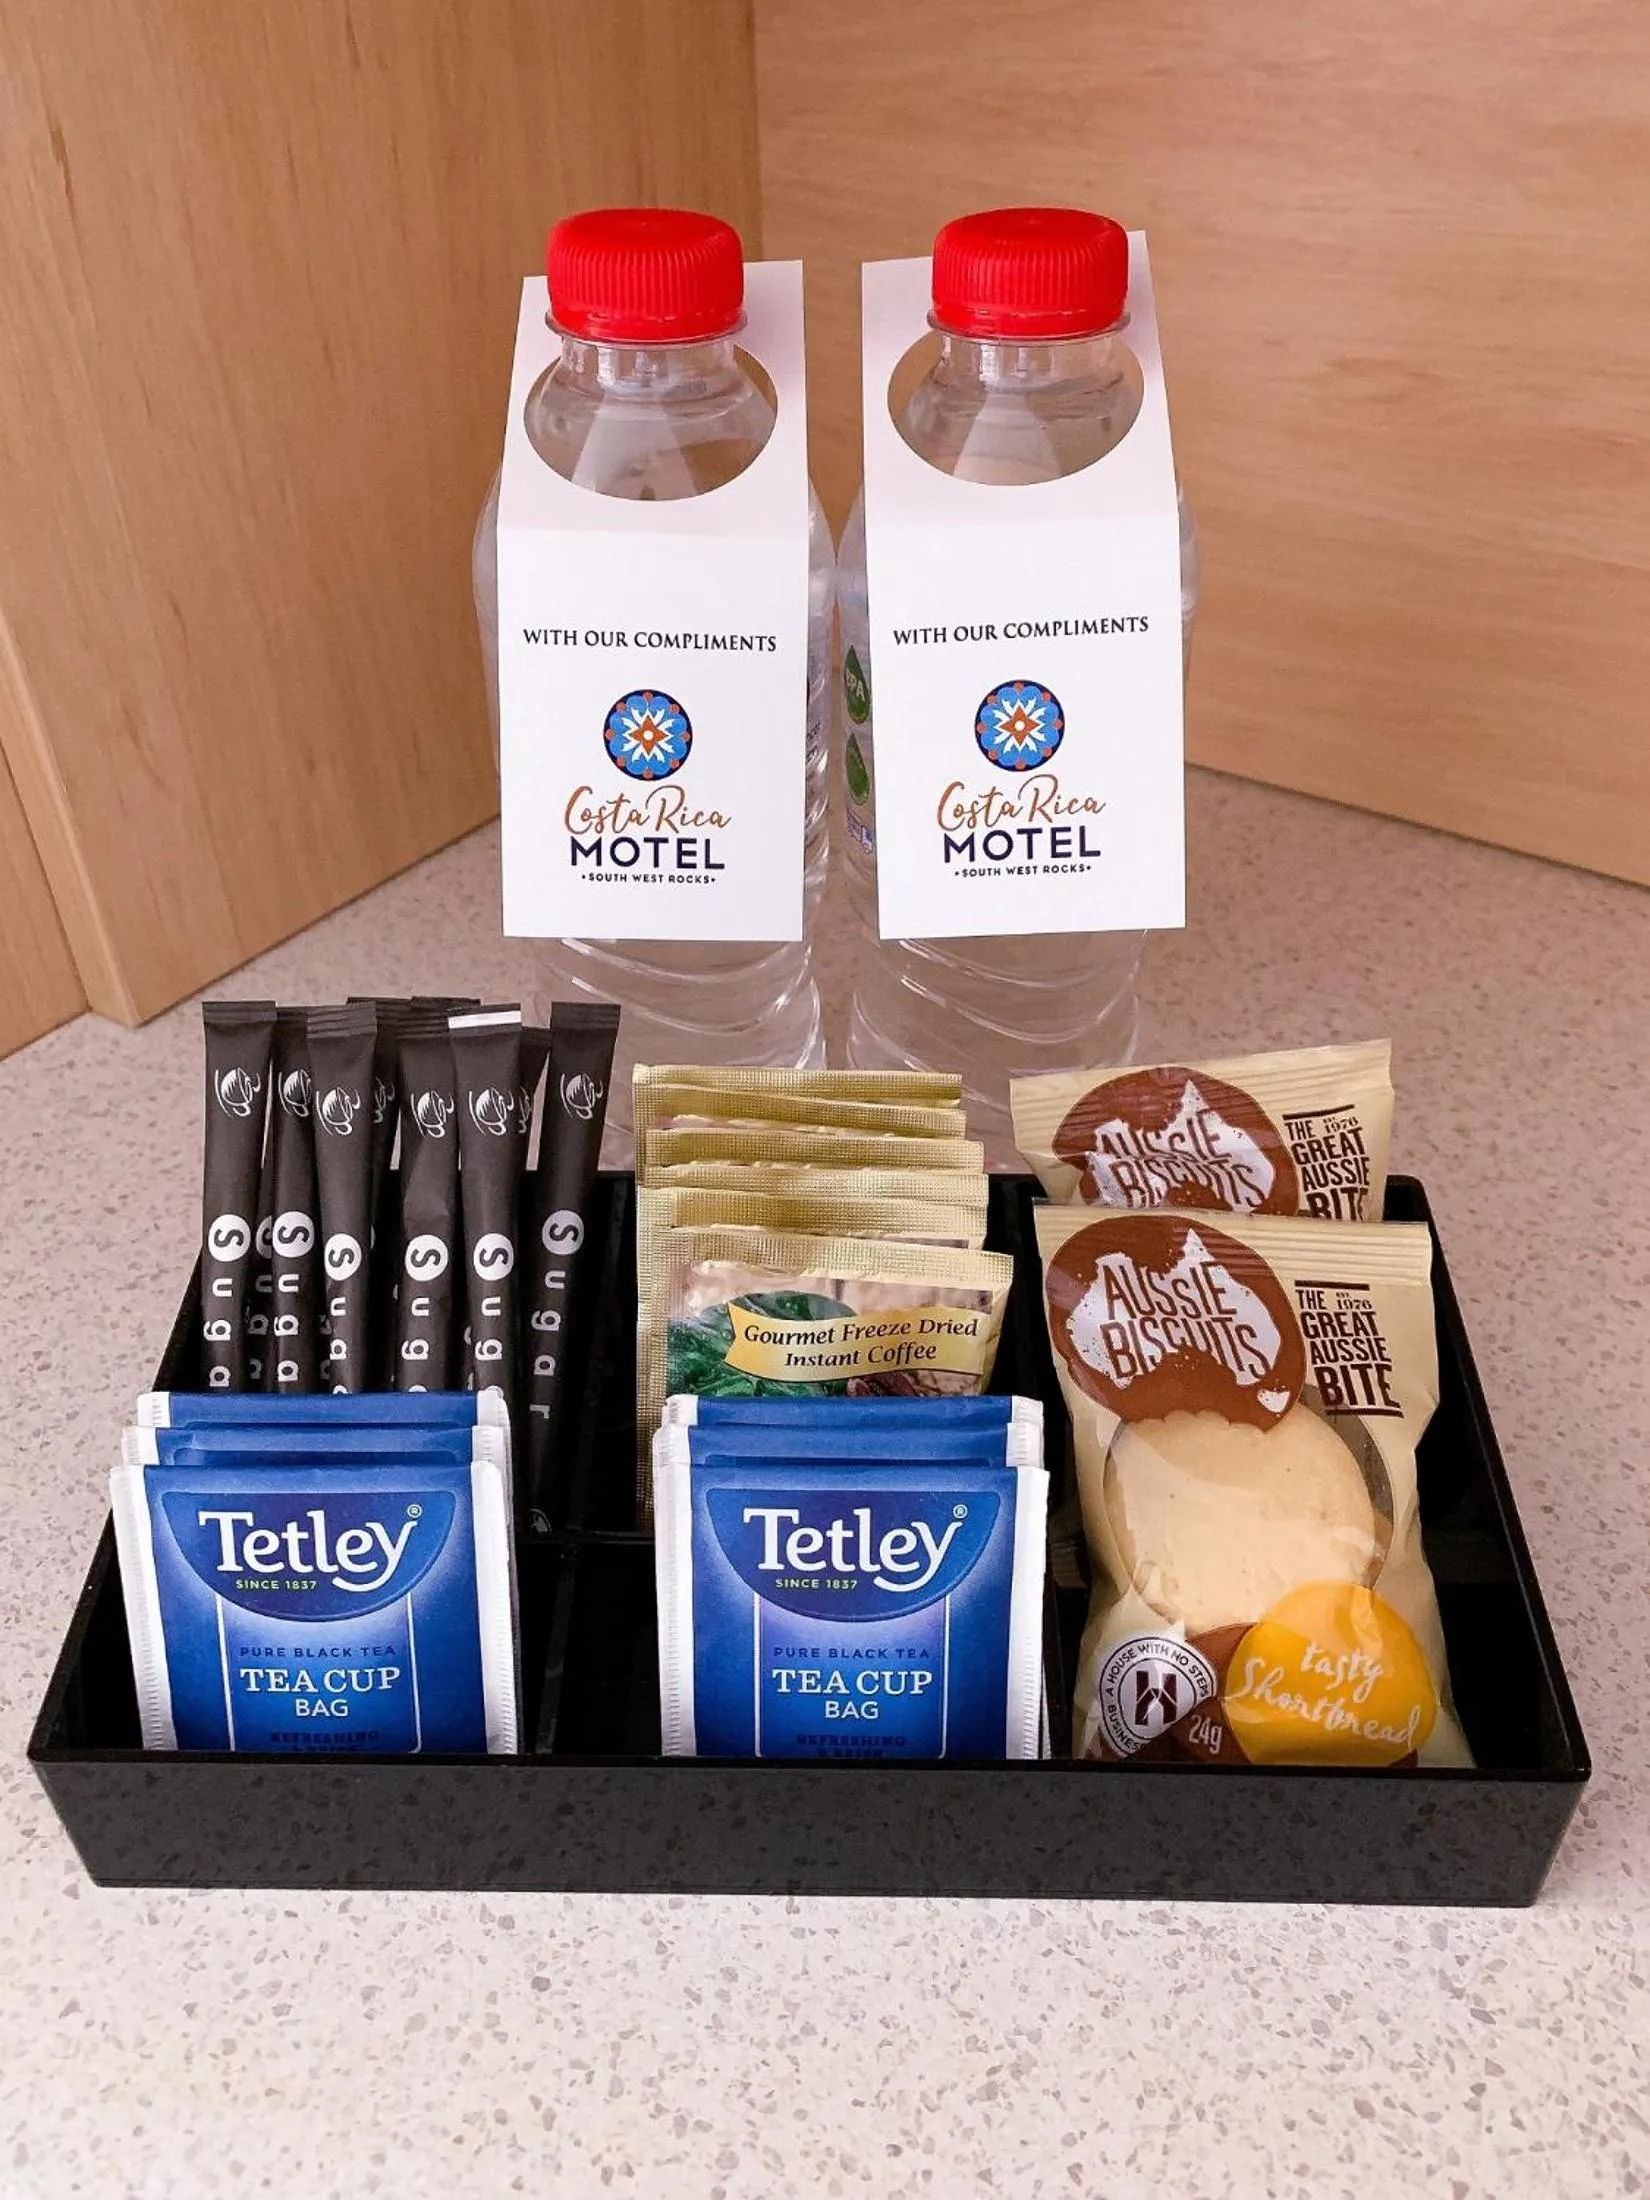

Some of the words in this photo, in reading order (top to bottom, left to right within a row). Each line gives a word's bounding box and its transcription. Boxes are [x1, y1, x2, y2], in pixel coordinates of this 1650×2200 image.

[522, 628, 578, 647] WITH
[584, 630, 628, 648] OUR
[634, 631, 777, 652] COMPLIMENTS
[892, 626, 947, 646] WITH
[953, 624, 999, 642] OUR
[1003, 616, 1149, 639] COMPLIMENTS
[564, 785, 650, 835] Costa
[645, 784, 732, 834] Rica
[936, 781, 1023, 831] Costa
[1017, 774, 1106, 823] Rica
[570, 836, 725, 870] MOTEL
[944, 825, 1101, 863] MOTEL
[588, 872, 628, 883] SOUTH
[632, 873, 664, 883] WEST
[669, 874, 710, 884] ROCKS
[962, 866, 1001, 878] SOUTH
[1006, 865, 1038, 876] WEST
[1043, 863, 1085, 874] ROCKS
[1101, 1108, 1232, 1162] AUSSIE
[1284, 1120, 1317, 1141] THE
[1292, 1128, 1366, 1166] GREAT
[1301, 1156, 1370, 1191] AUSSIE
[1102, 1260, 1238, 1320] AUSSIE
[1299, 1290, 1328, 1310] THE
[529, 1221, 580, 1419] Sugar
[744, 1324, 835, 1348] Gourmet
[842, 1320, 911, 1342] Freeze
[919, 1318, 978, 1337] Dried
[1301, 1311, 1380, 1339] GREAT
[784, 1351, 860, 1367] Instant
[867, 1343, 937, 1366] Coffee
[1100, 1317, 1270, 1380] BISCUITS
[1310, 1338, 1392, 1363] AUSSIE
[1313, 1364, 1401, 1408] BITE
[236, 1579, 279, 1590] SINCE
[286, 1580, 317, 1590] 1837
[776, 1578, 819, 1589] SINCE
[826, 1579, 857, 1590] 1837
[240, 1647, 285, 1658] PURE
[295, 1647, 351, 1658] BLACK
[361, 1646, 396, 1657] TEA
[774, 1647, 820, 1659] PURE
[829, 1648, 888, 1659] BLACK
[896, 1648, 930, 1659] TEA
[1138, 1643, 1169, 1656] WITH
[1171, 1650, 1189, 1666] NO
[240, 1669, 318, 1693] TEA
[324, 1667, 400, 1692] CUP
[1107, 1648, 1138, 1685] HOUSE
[1301, 1642, 1385, 1703] tasty
[773, 1669, 849, 1695] TEA
[856, 1669, 933, 1696] CUP
[1105, 1687, 1115, 1696] A
[295, 1700, 349, 1718] BAG
[825, 1701, 879, 1720] BAG
[1188, 1715, 1224, 1755] 24g
